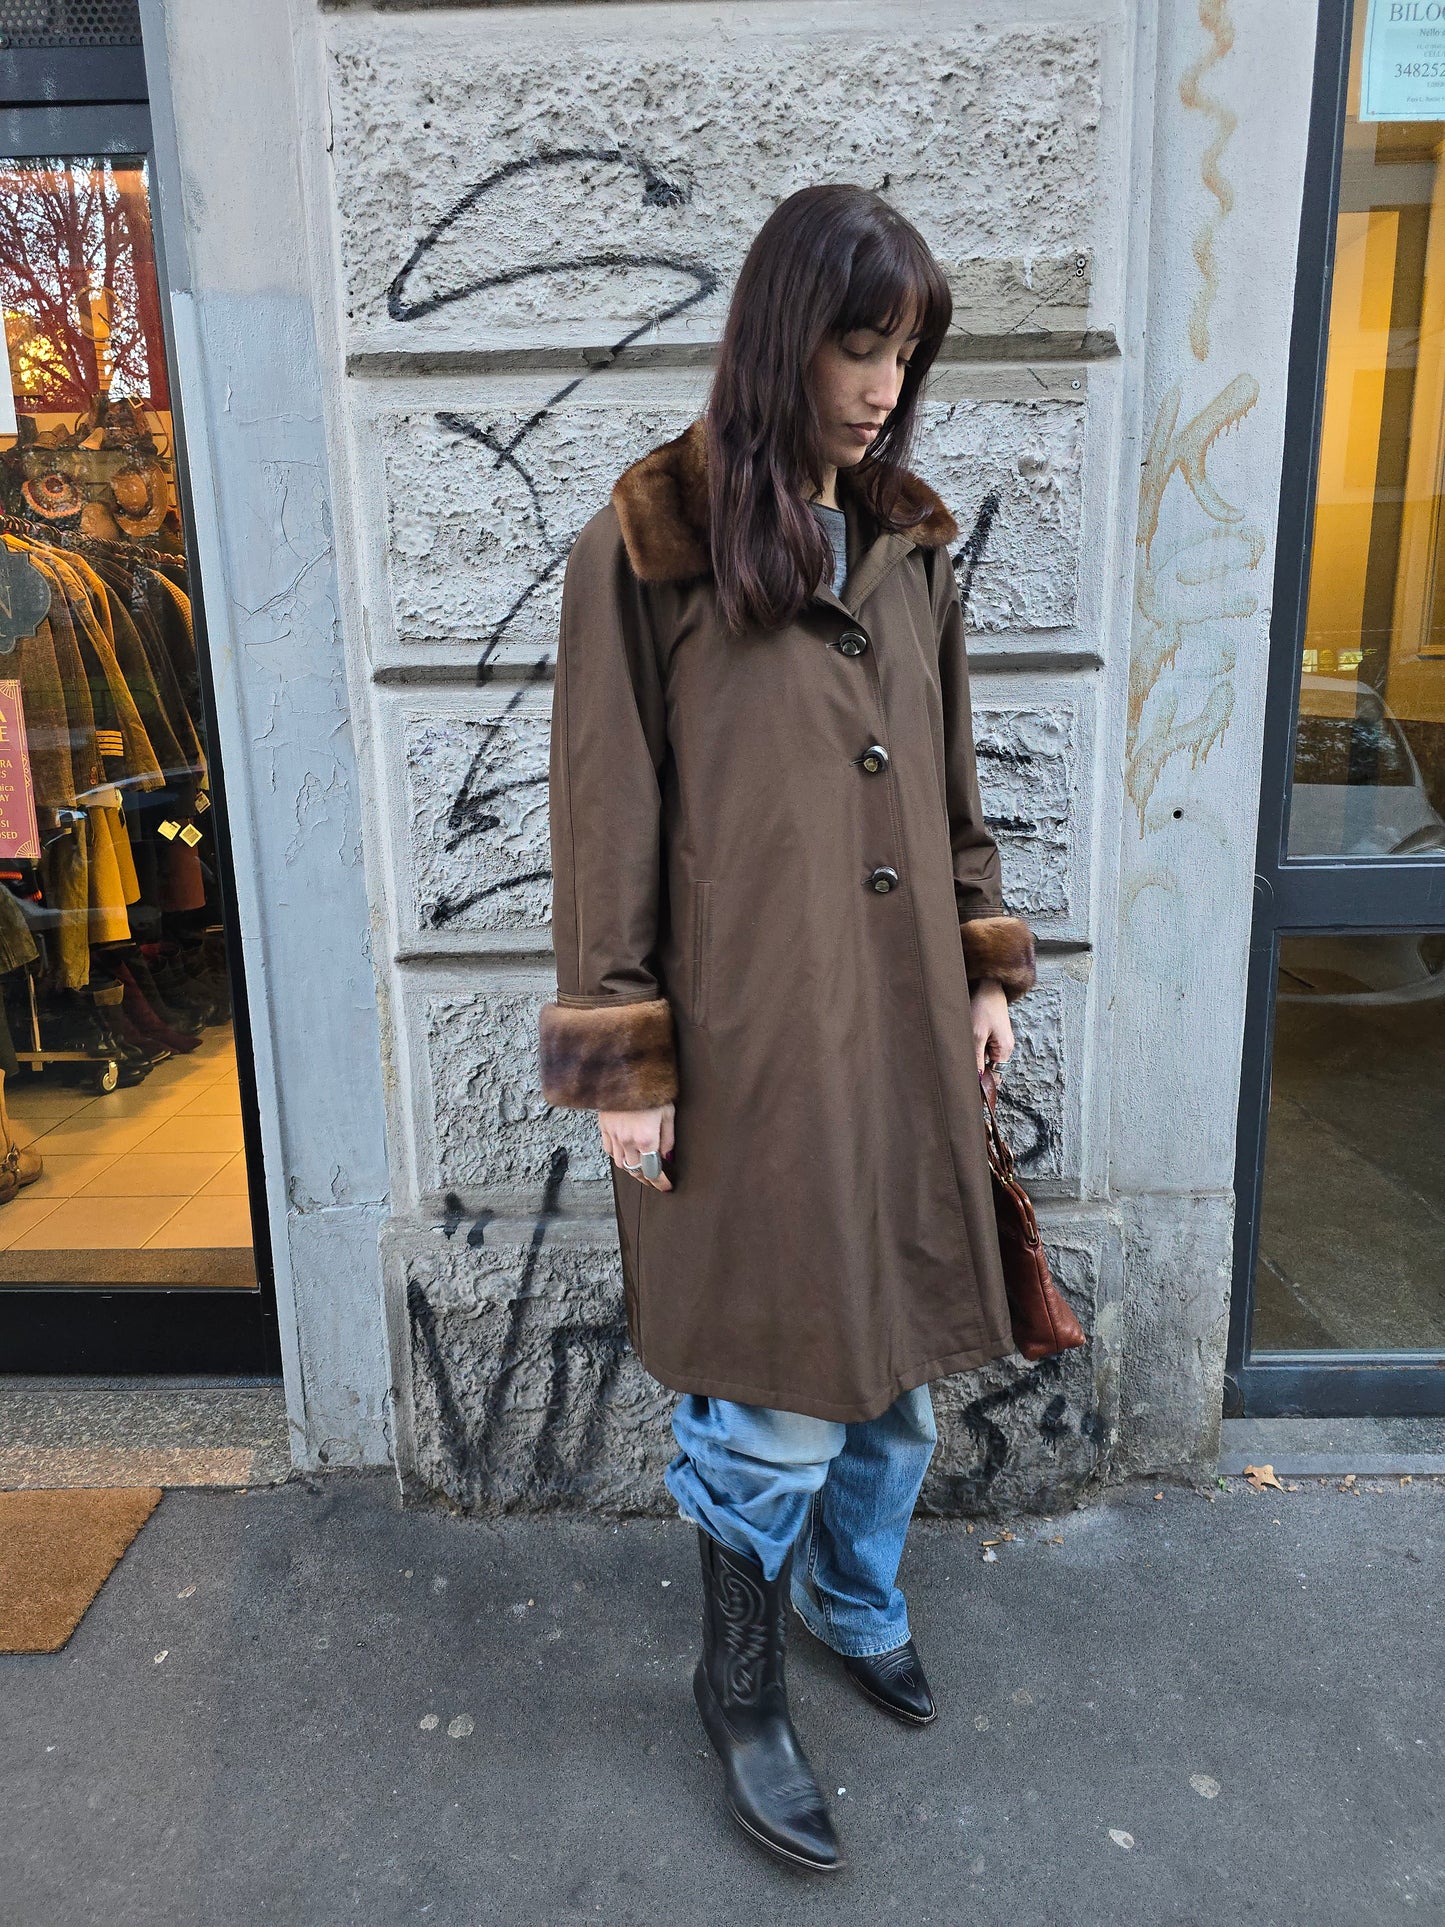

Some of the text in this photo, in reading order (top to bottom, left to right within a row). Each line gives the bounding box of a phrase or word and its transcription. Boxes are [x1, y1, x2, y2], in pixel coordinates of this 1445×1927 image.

[1389, 3, 1445, 22] BILO
[1394, 63, 1445, 78] 348252
[0, 831, 18, 840] SED
